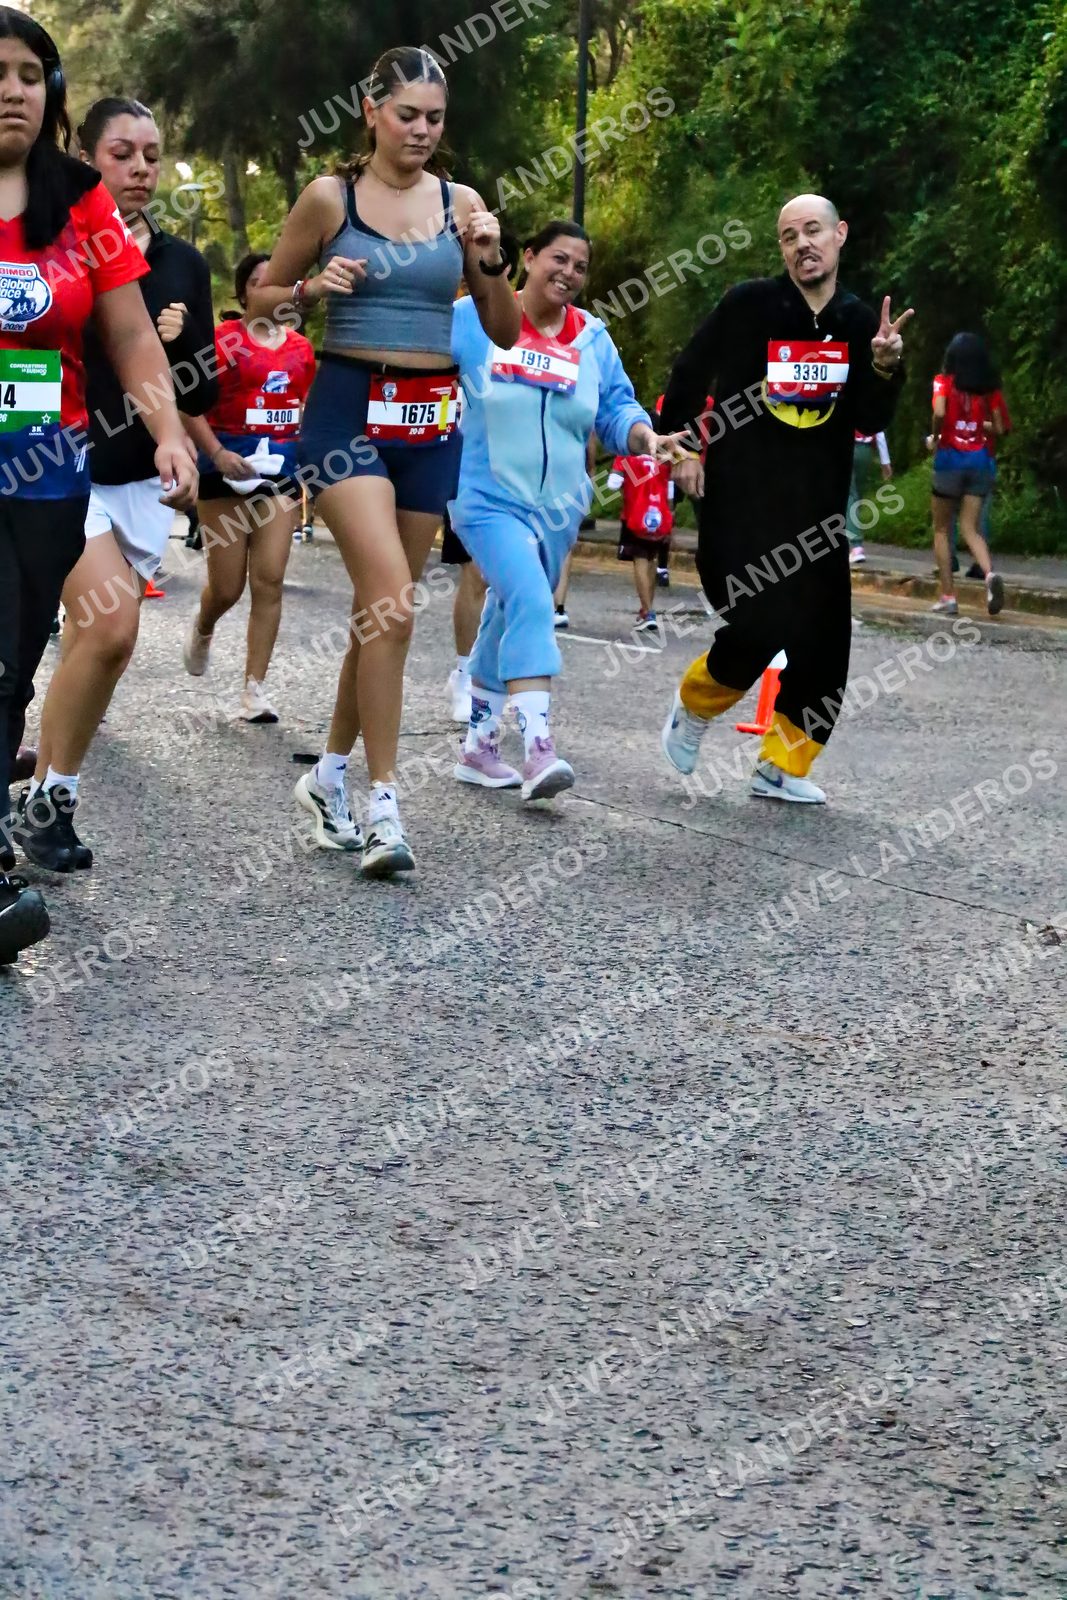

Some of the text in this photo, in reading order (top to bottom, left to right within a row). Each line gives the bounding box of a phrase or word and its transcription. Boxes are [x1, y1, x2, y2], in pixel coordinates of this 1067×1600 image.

[1, 279, 34, 291] Global
[0, 288, 22, 299] ace
[3, 322, 25, 331] 2026
[521, 350, 550, 370] 1913
[794, 365, 828, 381] 3330
[0, 384, 16, 408] 4
[266, 410, 293, 424] 3400
[401, 404, 436, 424] 1675
